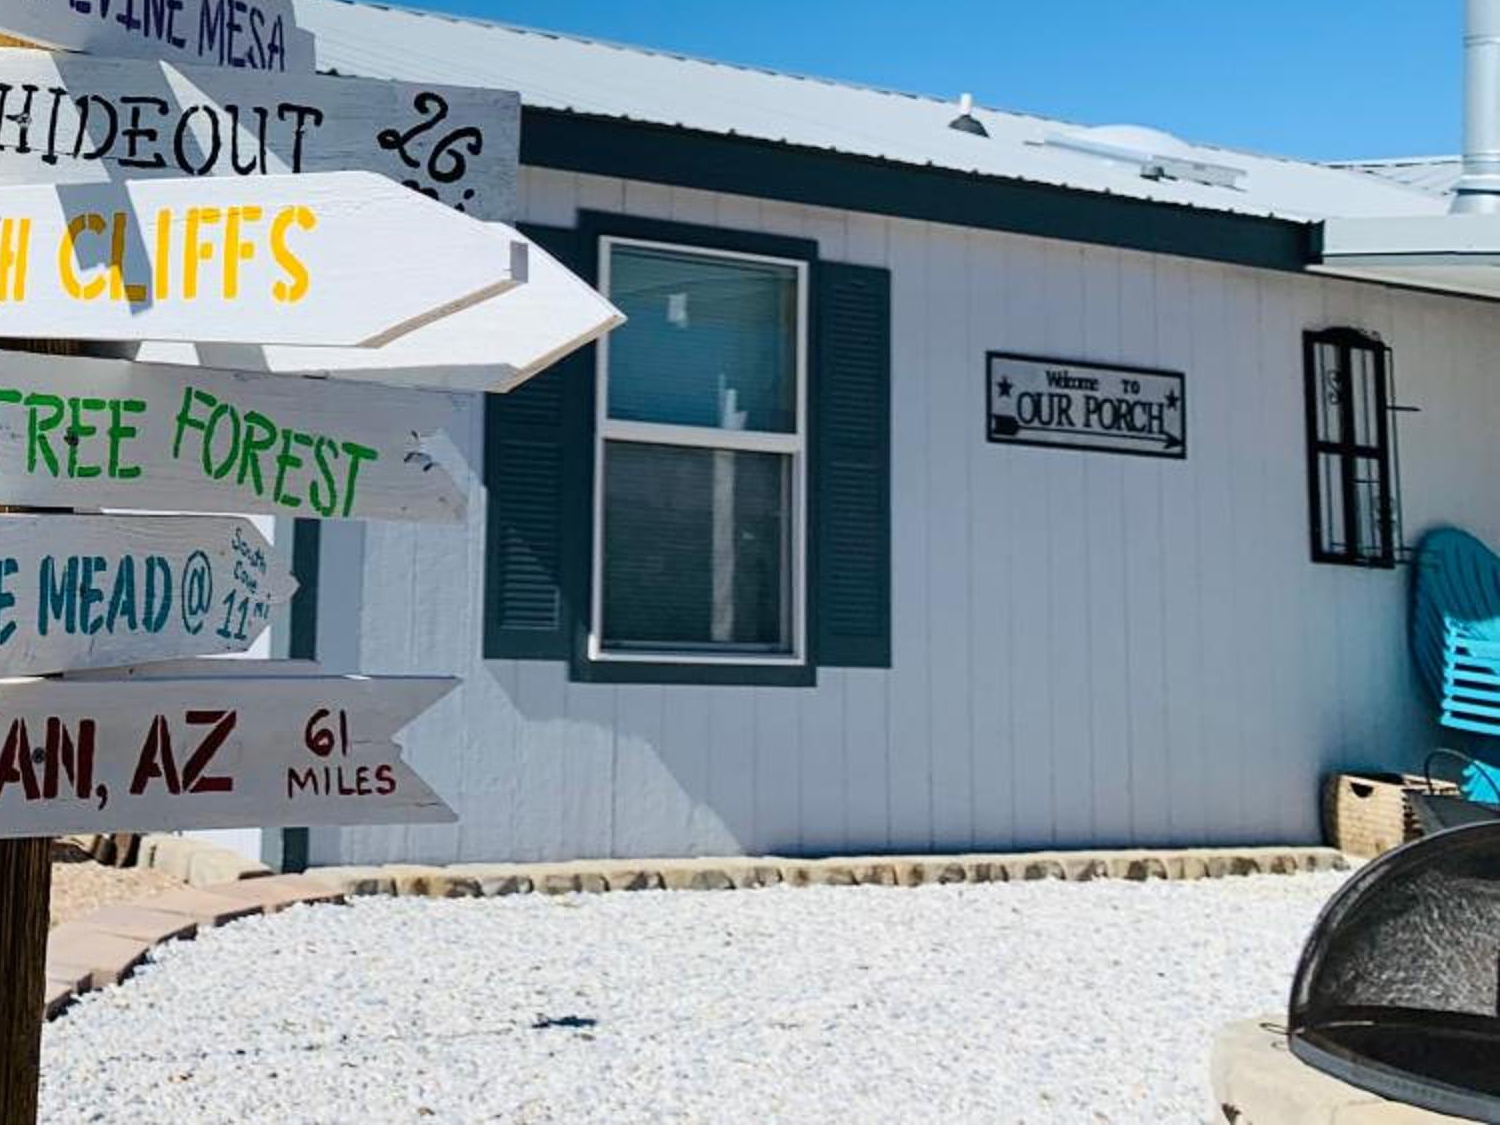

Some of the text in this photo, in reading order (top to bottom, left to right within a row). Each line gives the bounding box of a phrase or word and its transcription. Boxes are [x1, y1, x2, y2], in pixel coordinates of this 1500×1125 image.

[377, 92, 482, 183] 26
[58, 206, 318, 303] CLIFFS
[173, 386, 378, 517] FOREST
[1017, 391, 1165, 435] OUR PORCH
[129, 709, 238, 796] AZ
[304, 708, 348, 757] 61
[287, 764, 397, 799] MILES
